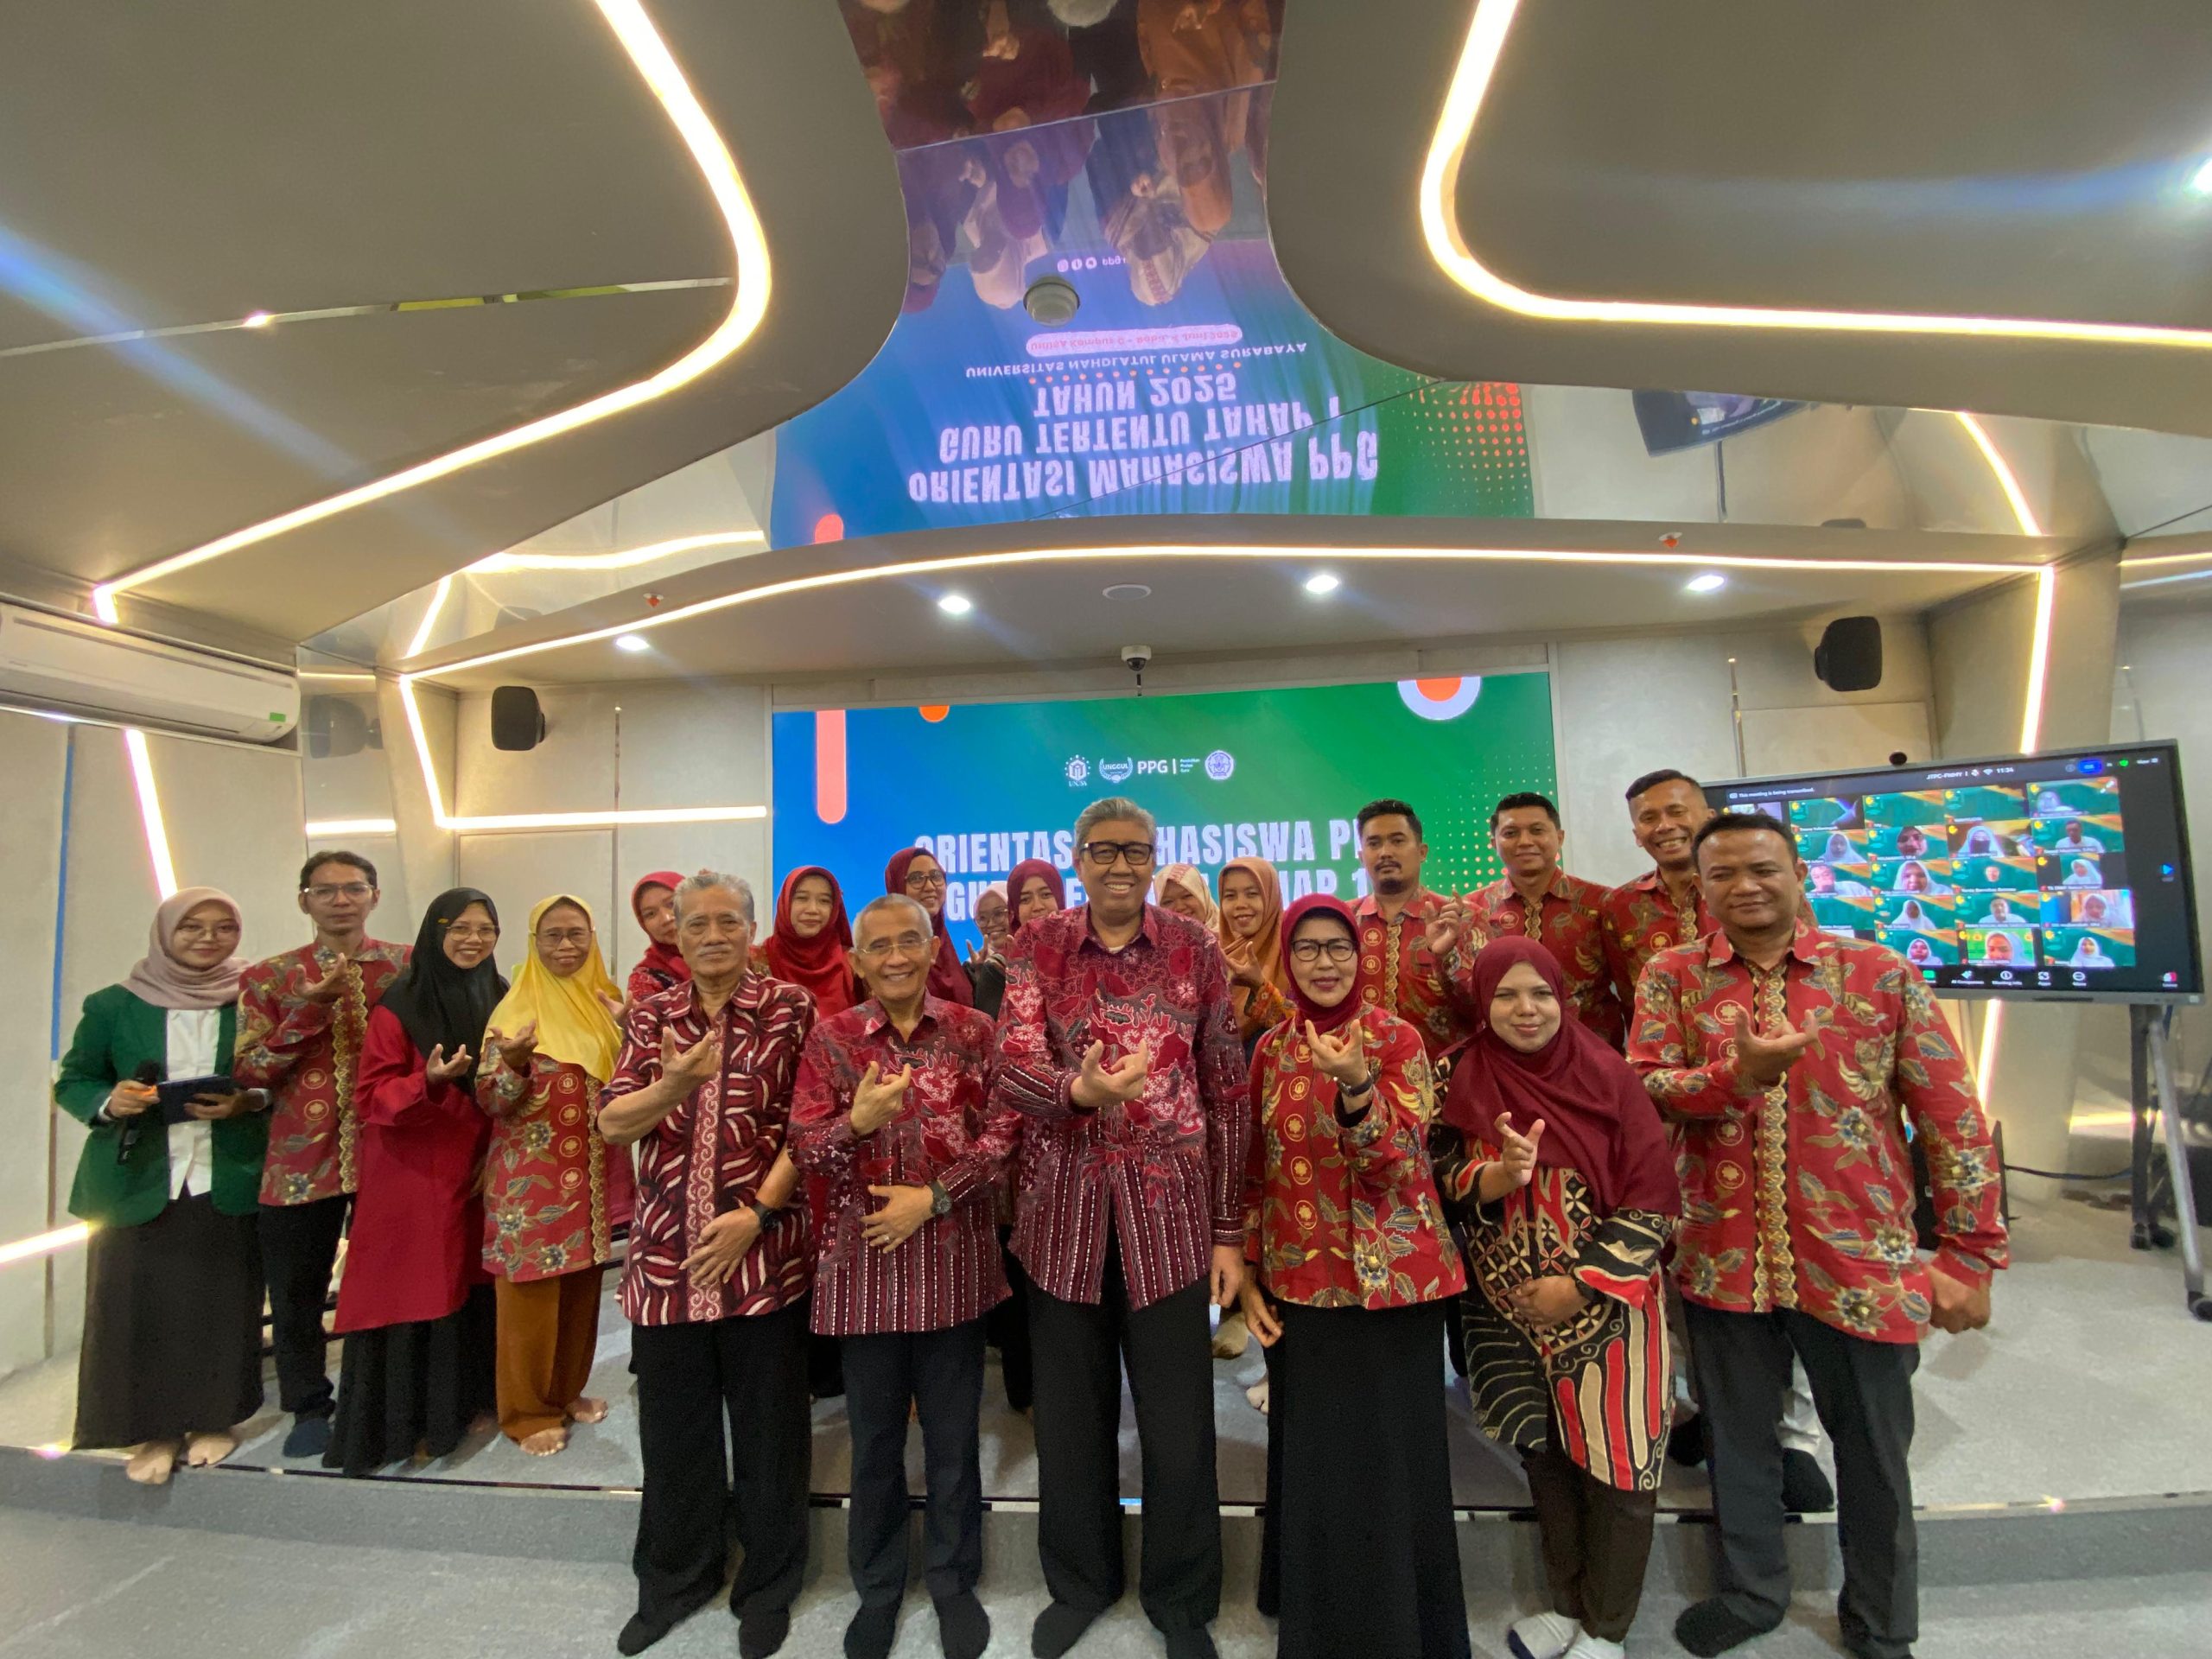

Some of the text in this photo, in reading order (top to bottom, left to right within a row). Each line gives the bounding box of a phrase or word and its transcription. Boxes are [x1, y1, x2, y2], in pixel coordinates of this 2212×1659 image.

[1137, 759, 1167, 775] PPG
[914, 830, 1073, 874] RIENTAS
[1156, 820, 1316, 866] HASISWA
